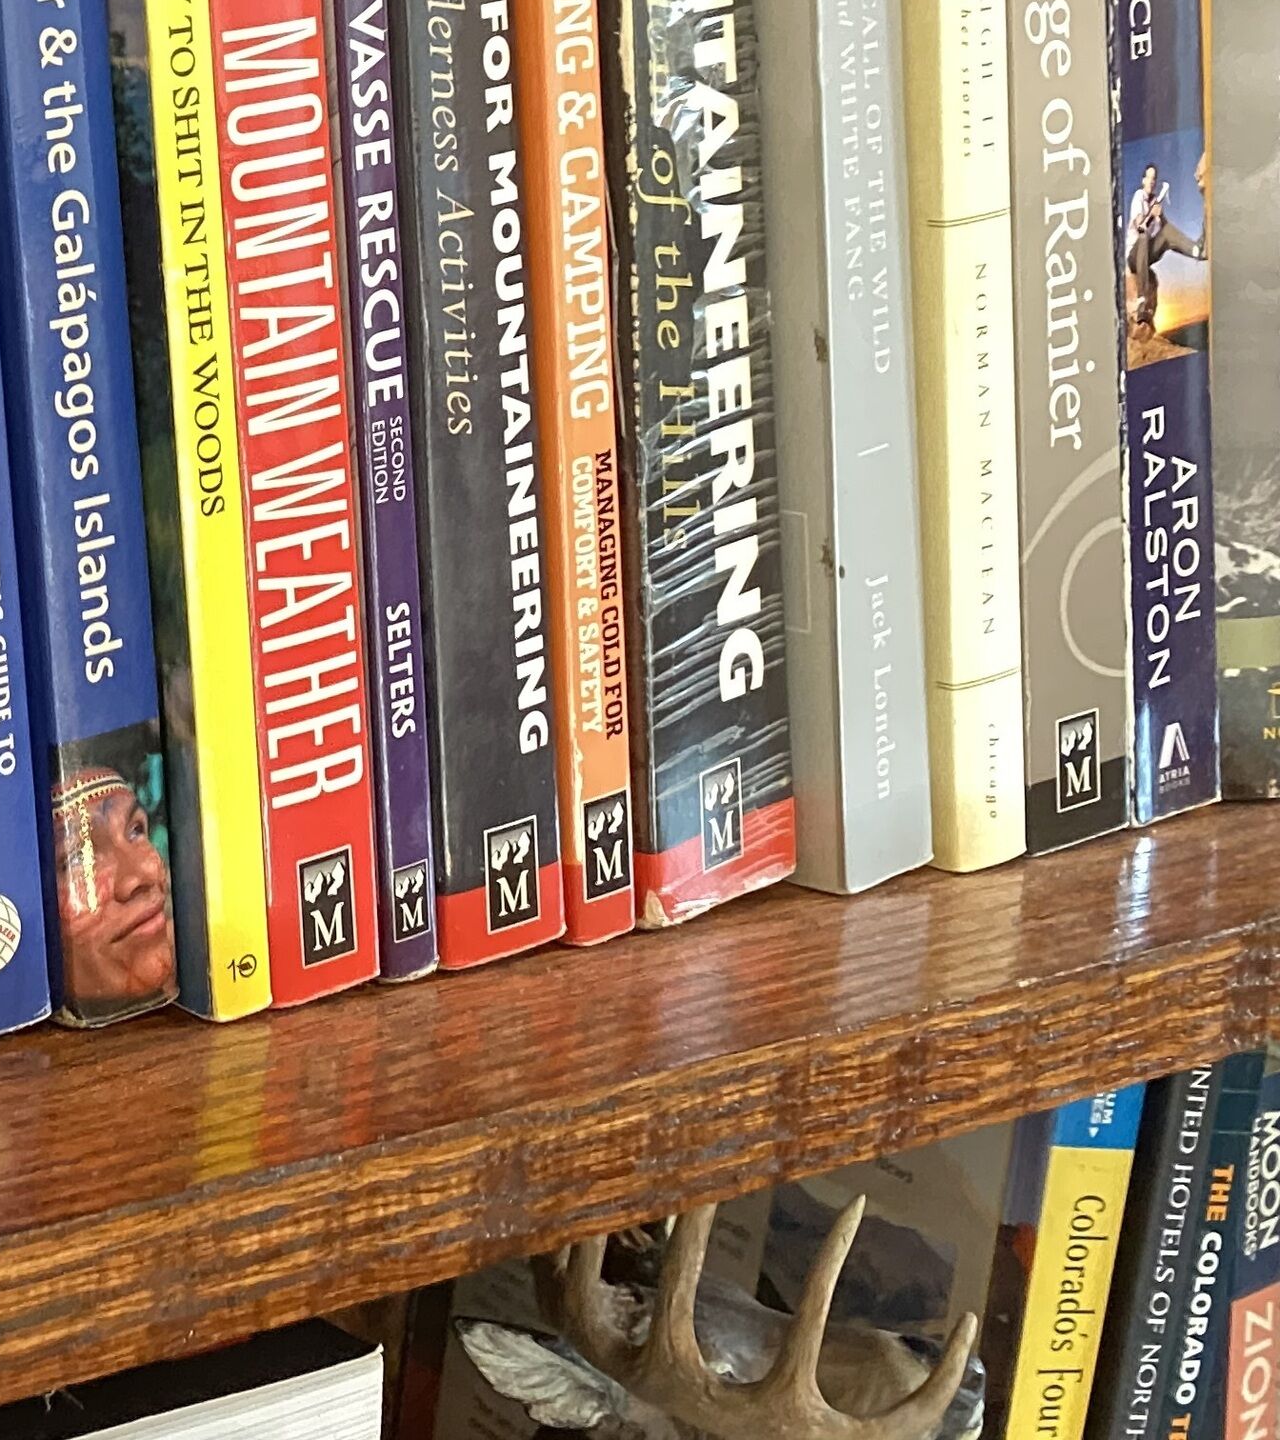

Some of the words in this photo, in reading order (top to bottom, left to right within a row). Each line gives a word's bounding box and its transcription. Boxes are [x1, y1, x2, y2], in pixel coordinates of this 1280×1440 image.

[38, 26, 78, 69] &
[167, 20, 198, 79] TO
[479, 0, 515, 135] FOR
[43, 79, 85, 175] the
[170, 85, 203, 188] SHIT
[557, 92, 598, 137] &
[840, 41, 860, 179] WHITE
[865, 103, 884, 155] OF
[1041, 98, 1092, 174] of
[180, 197, 207, 246] IN
[220, 14, 342, 438] MOUNTAIN
[844, 195, 865, 303] FANG
[867, 168, 888, 253] THE
[49, 188, 99, 482] Galápagos
[184, 252, 215, 346] THE
[357, 190, 404, 409] RESCUE
[436, 192, 480, 437] Activities
[560, 147, 613, 421] CAMPING
[870, 266, 894, 375] WILD
[1044, 188, 1096, 451] Rainier
[192, 353, 226, 519] WOODS
[371, 419, 390, 506] EDITION
[387, 414, 407, 504] SECOND
[486, 149, 551, 755] MOUNTAINEERING
[572, 455, 597, 591] COMFORT
[595, 448, 618, 601] MANAGING
[1141, 404, 1172, 692] RALSTON
[1171, 455, 1202, 625] ARON
[73, 493, 125, 685] Islands
[250, 440, 364, 810] WEATHER
[577, 596, 599, 620] &
[601, 609, 621, 679] COLD
[865, 574, 892, 652] Jack
[385, 601, 417, 740] SELTERS
[579, 621, 604, 733] SAFETY
[605, 681, 624, 741] FOR
[869, 663, 898, 801] London
[1159, 764, 1191, 785] ATRIA
[1205, 1163, 1236, 1223] THE
[1050, 1193, 1110, 1353] Colorado's
[1175, 1231, 1224, 1406] COLORADO
